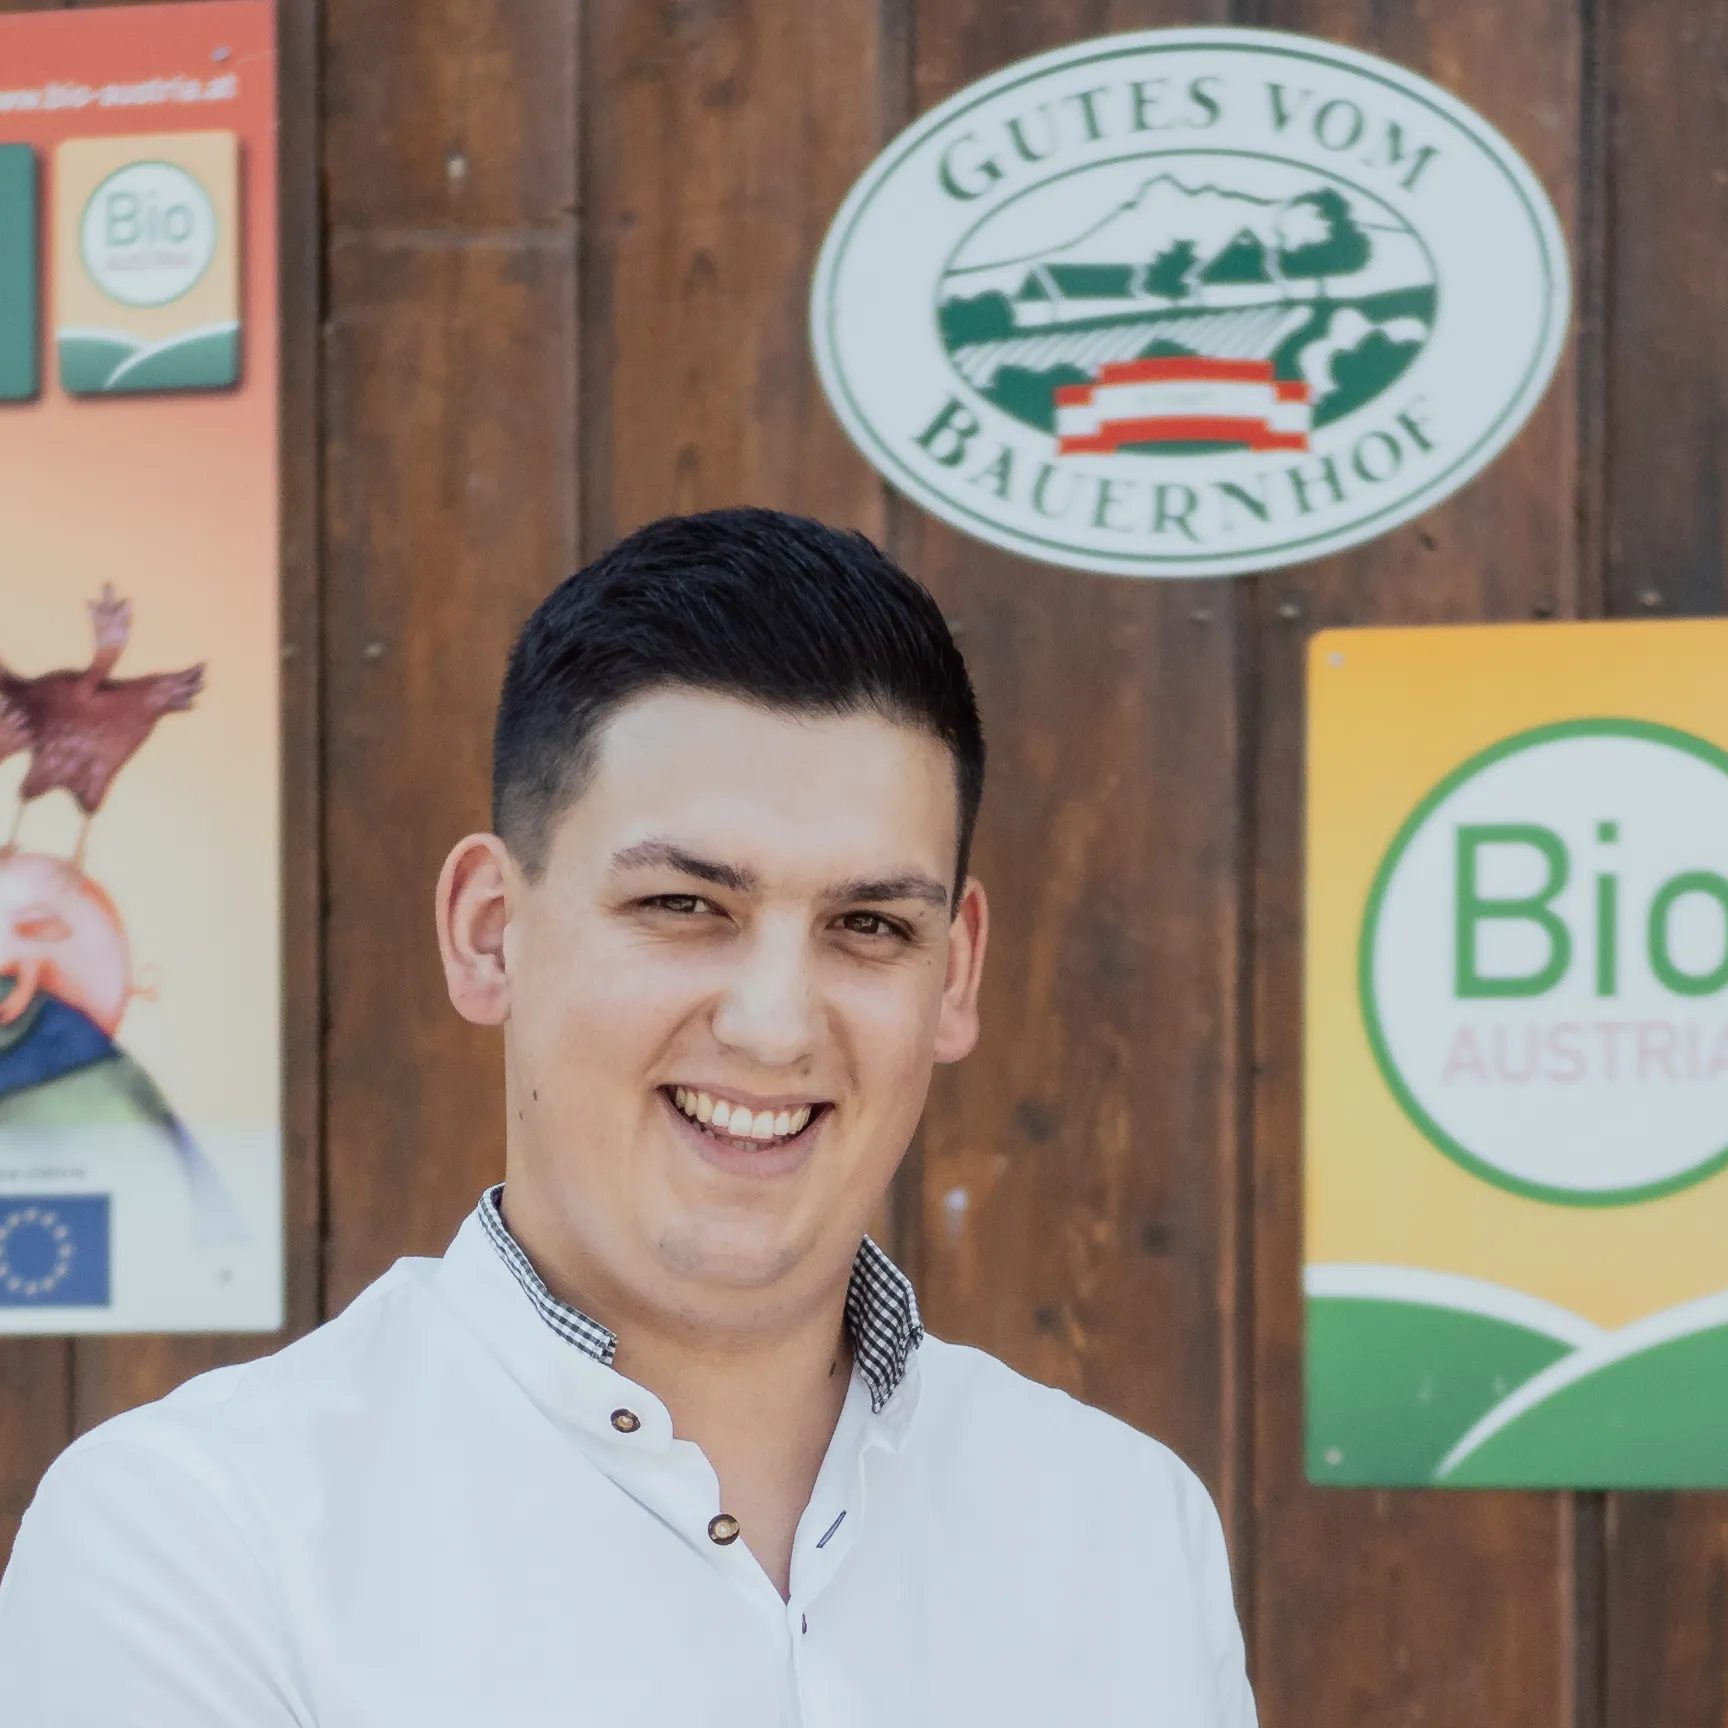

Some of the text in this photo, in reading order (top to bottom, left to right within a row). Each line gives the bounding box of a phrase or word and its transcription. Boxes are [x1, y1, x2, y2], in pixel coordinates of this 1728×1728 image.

[936, 75, 1448, 201] GUTES VOM
[106, 189, 194, 247] Bio
[914, 392, 1445, 543] BAUERNHOF
